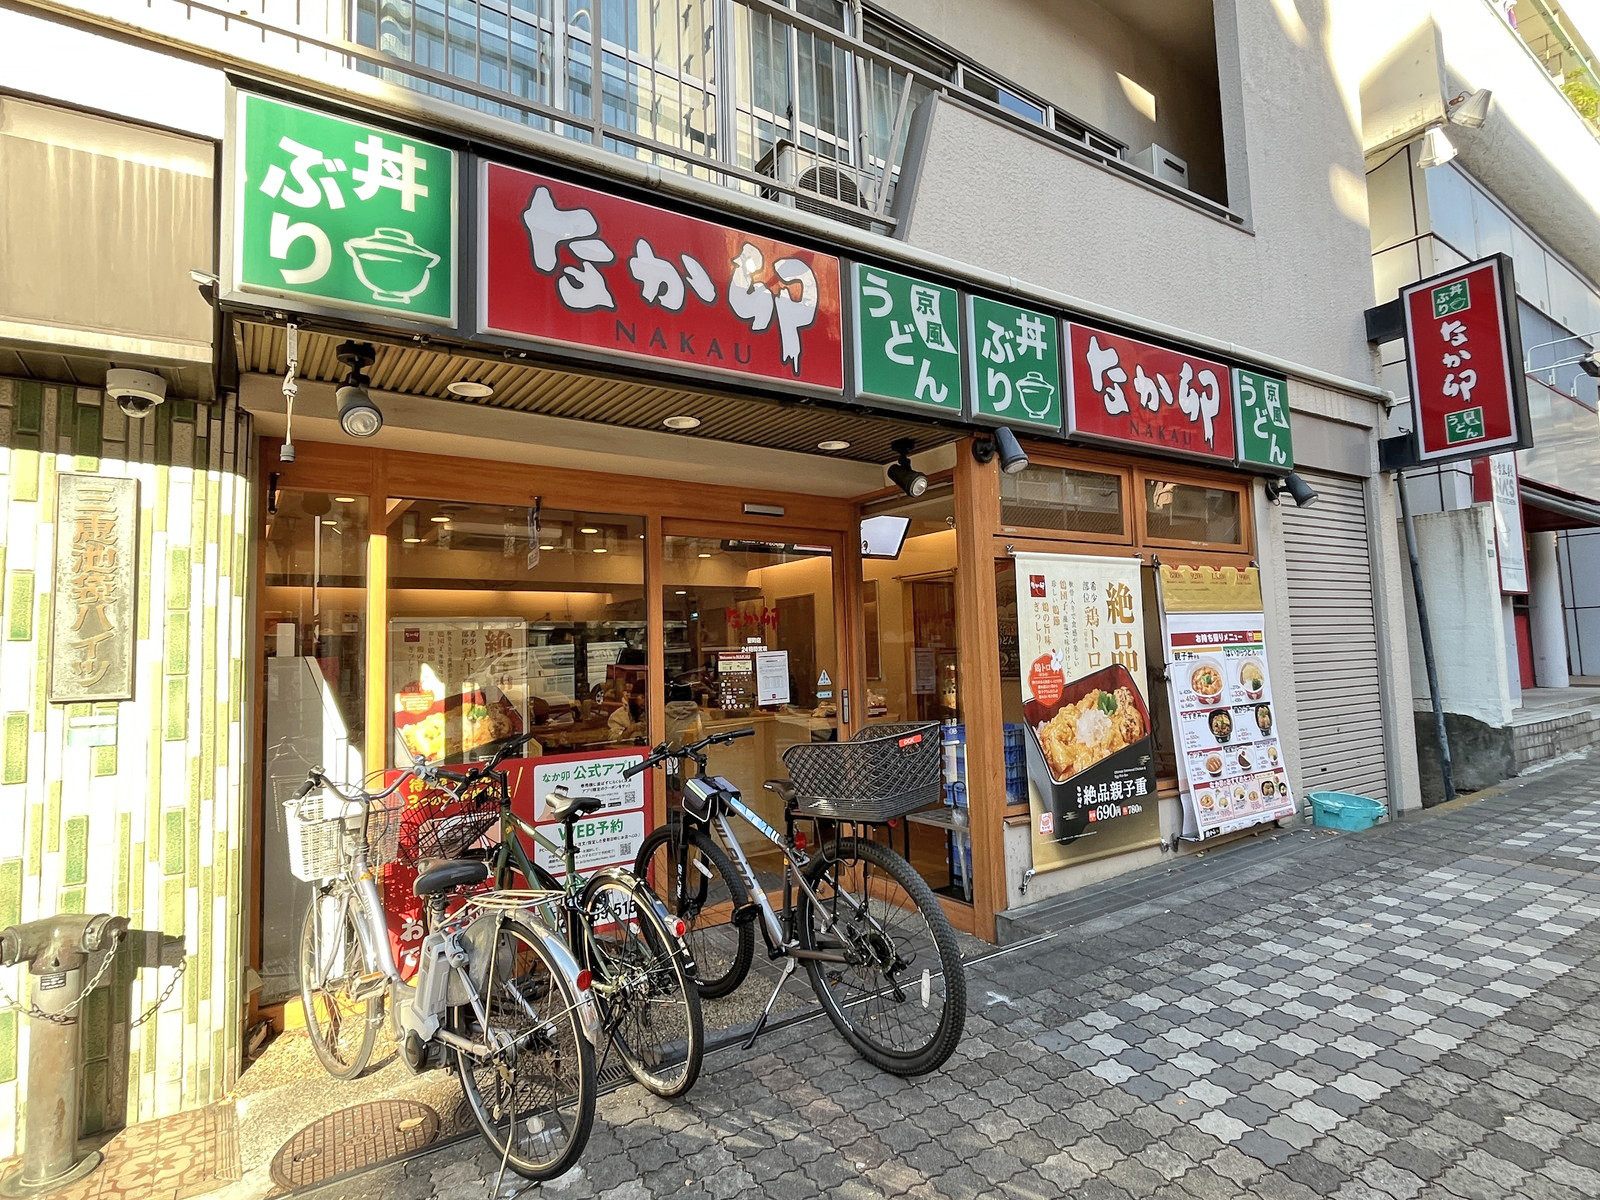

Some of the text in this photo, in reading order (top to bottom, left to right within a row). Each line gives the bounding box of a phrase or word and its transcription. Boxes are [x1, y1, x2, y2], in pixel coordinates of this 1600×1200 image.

[523, 185, 818, 375] なか卯
[615, 320, 751, 364] NAKAU
[862, 272, 948, 402] うどん
[915, 290, 945, 348] 京風
[1440, 320, 1477, 402] なか卯
[1086, 335, 1219, 450] なか卯
[1129, 420, 1192, 446] NAKAU
[1240, 375, 1287, 464] うどん
[1447, 414, 1479, 438] うどん
[1085, 606, 1101, 669] 鶏トロ
[1106, 582, 1139, 673] 絶品
[1195, 632, 1243, 643] お持ち帰りメニュー
[1174, 651, 1194, 661] 親子丼
[542, 772, 571, 783] なか卯
[1083, 776, 1148, 806] 絶品親子重
[1096, 802, 1121, 821] 690円
